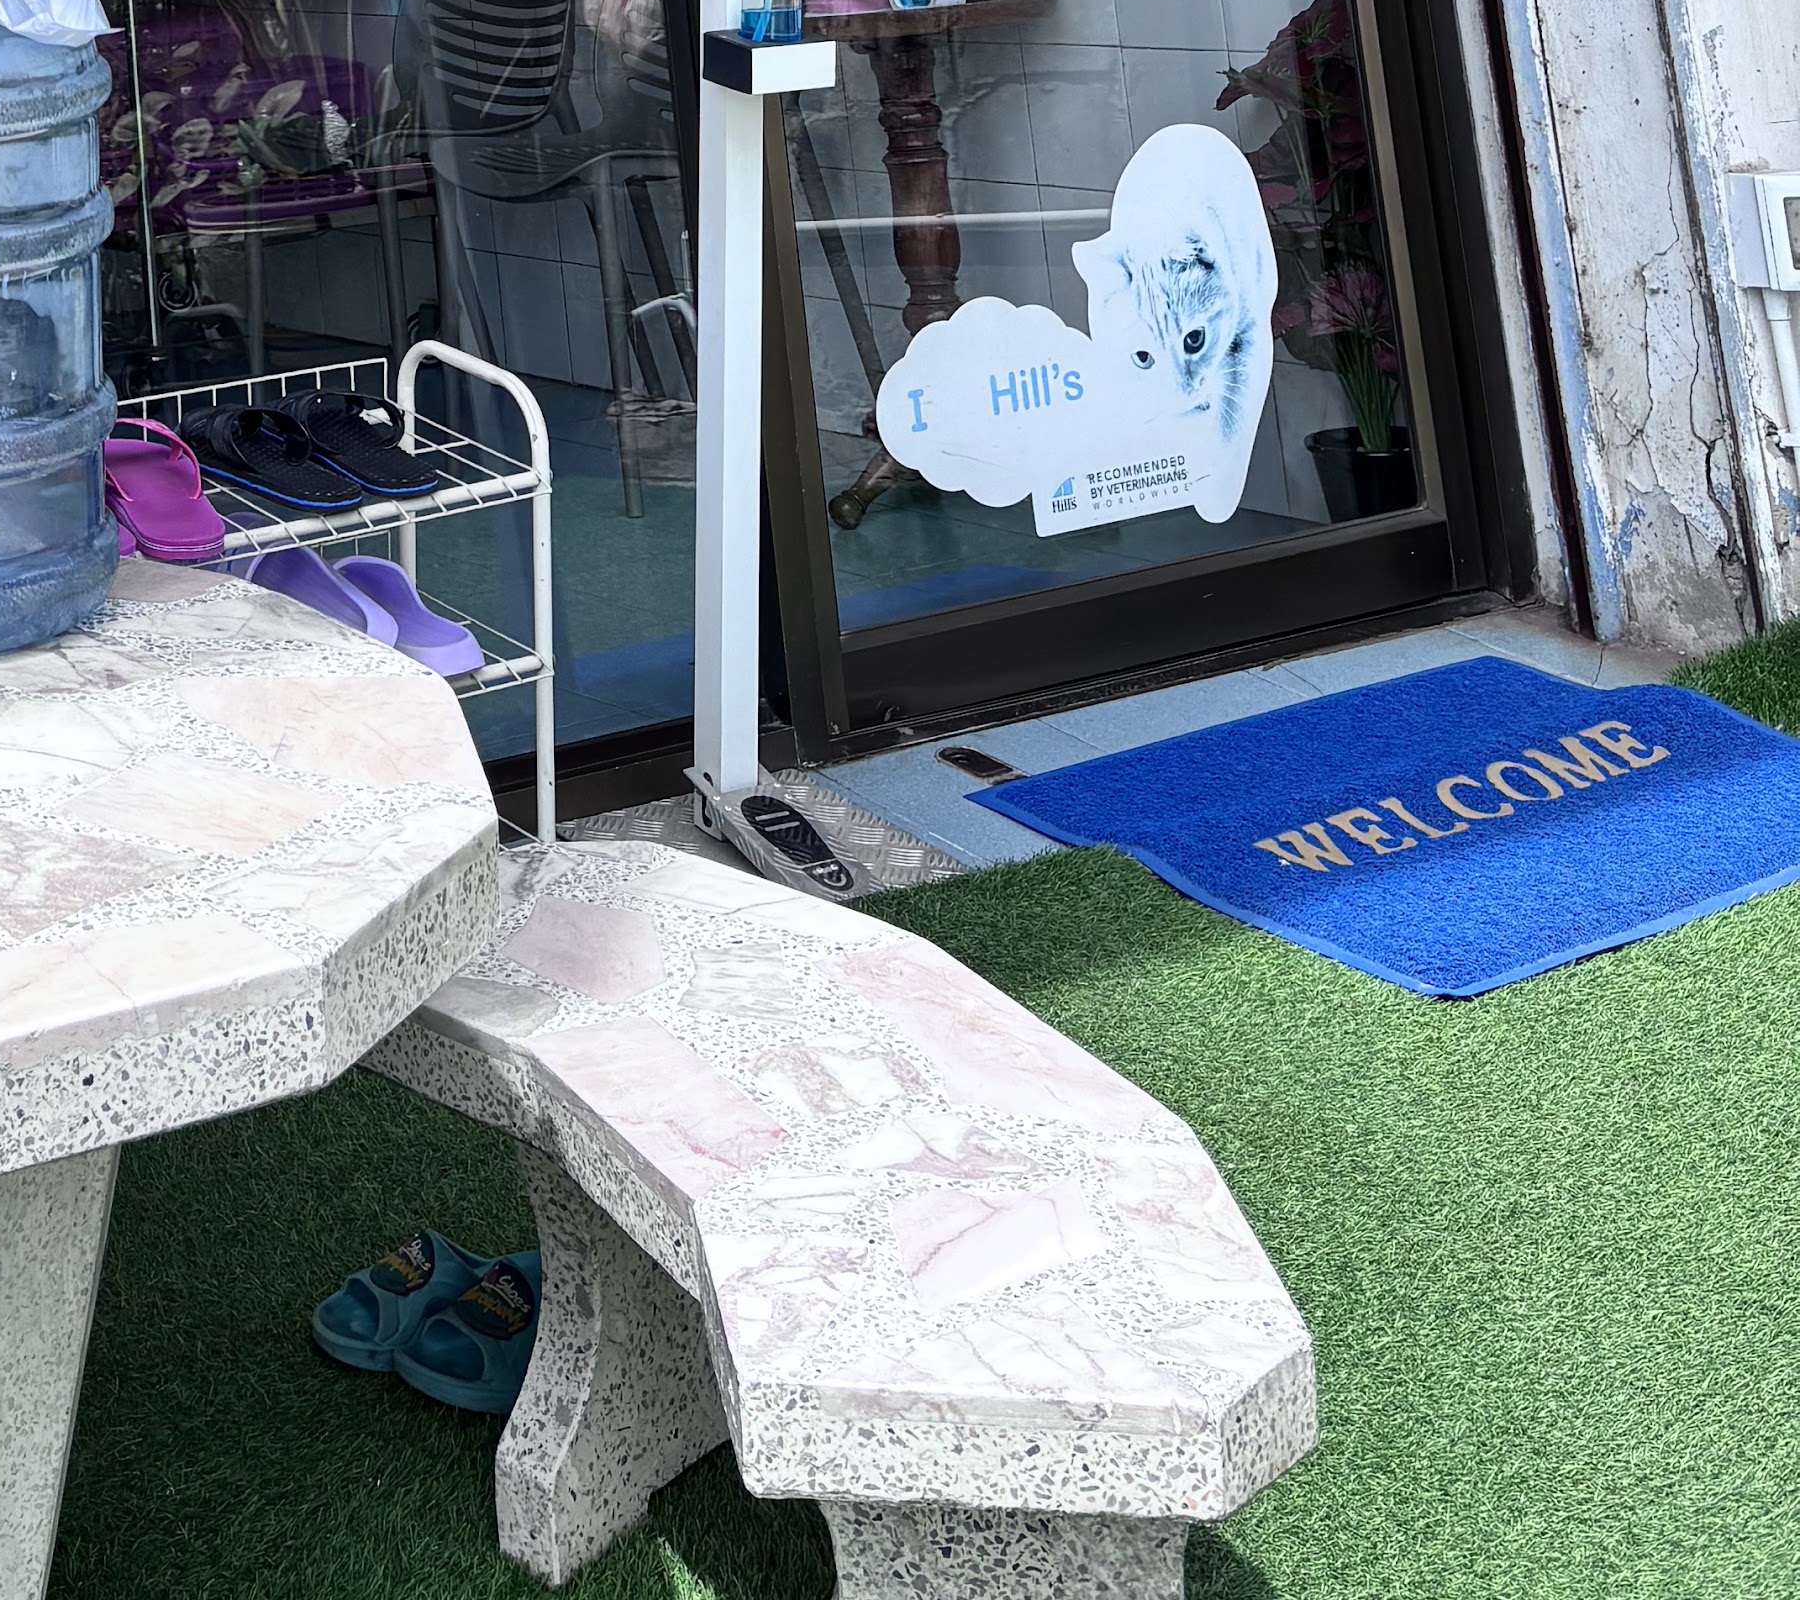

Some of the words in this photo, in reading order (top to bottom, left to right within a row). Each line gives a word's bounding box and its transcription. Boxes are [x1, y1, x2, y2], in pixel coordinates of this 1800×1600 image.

[907, 388, 928, 433] I
[990, 363, 1085, 416] Hill's
[1086, 455, 1187, 485] RECOMMENDED
[1090, 485, 1105, 500] BY
[1105, 468, 1189, 497] VETERINARIANS
[1091, 481, 1194, 511] WORLDWIDE
[1253, 720, 1672, 874] WELCOME
